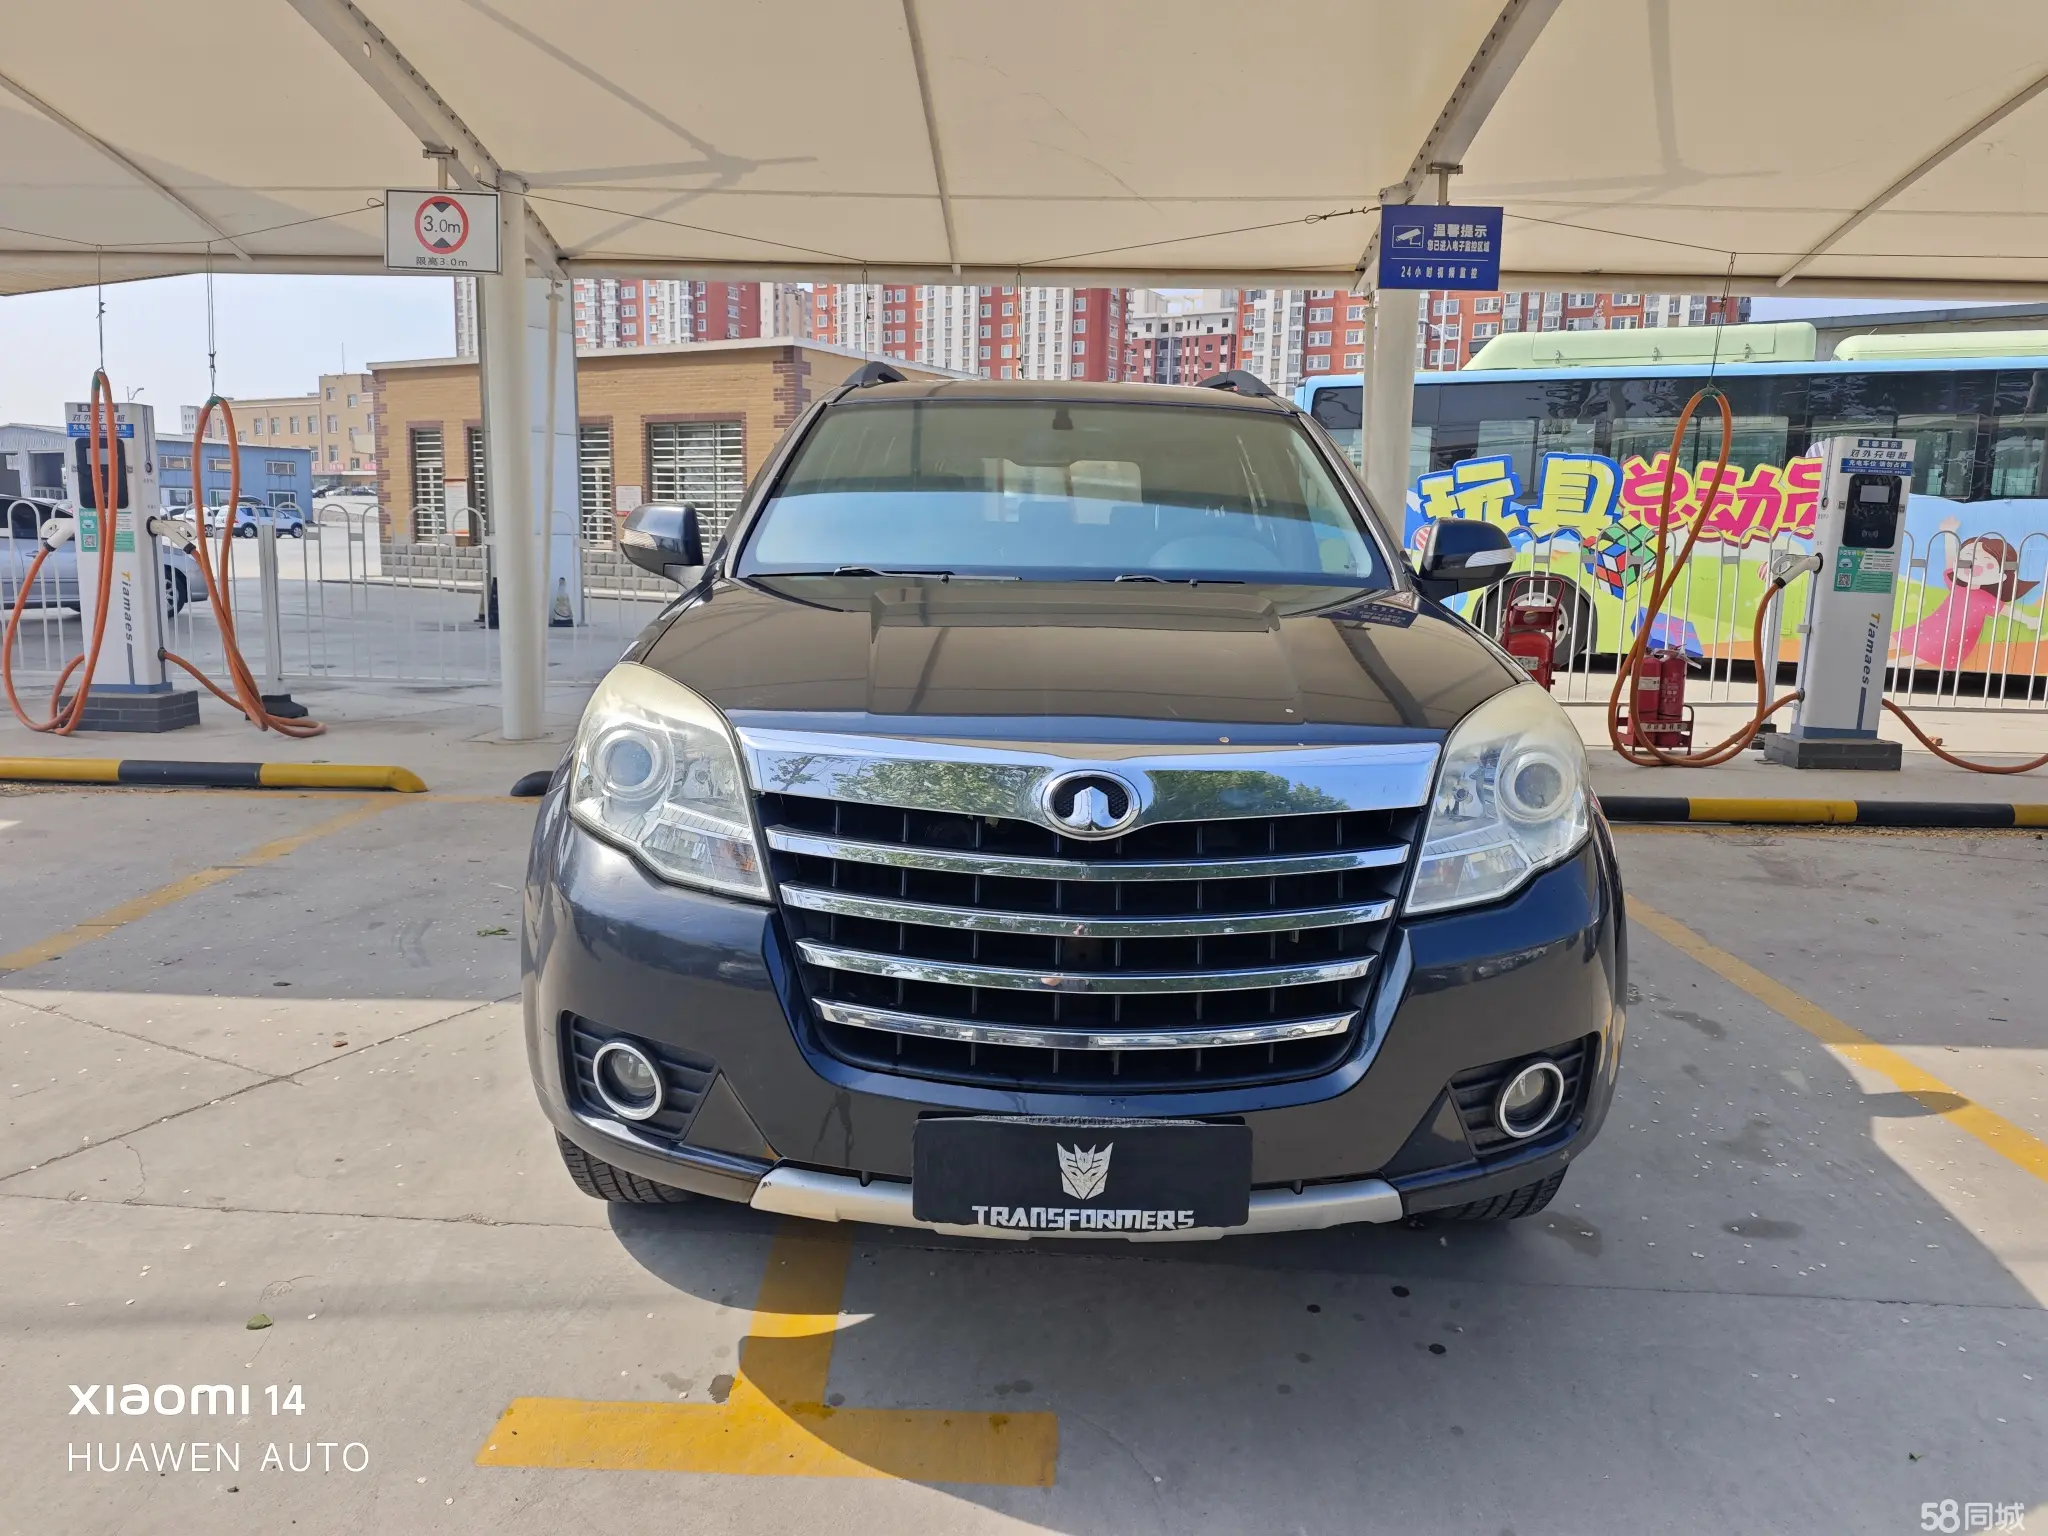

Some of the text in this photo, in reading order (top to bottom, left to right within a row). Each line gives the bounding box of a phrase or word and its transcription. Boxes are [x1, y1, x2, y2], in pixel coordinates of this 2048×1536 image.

[423, 215, 461, 234] 3.0m
[1433, 223, 1488, 238] 温馨提示
[1427, 239, 1490, 252] 您已进入电子监控区域
[415, 256, 468, 267] 限高3.0m
[120, 571, 133, 642] Tiamaes
[1861, 612, 1882, 685] Tiamaes
[972, 1205, 1195, 1231] TRANSFORMERS
